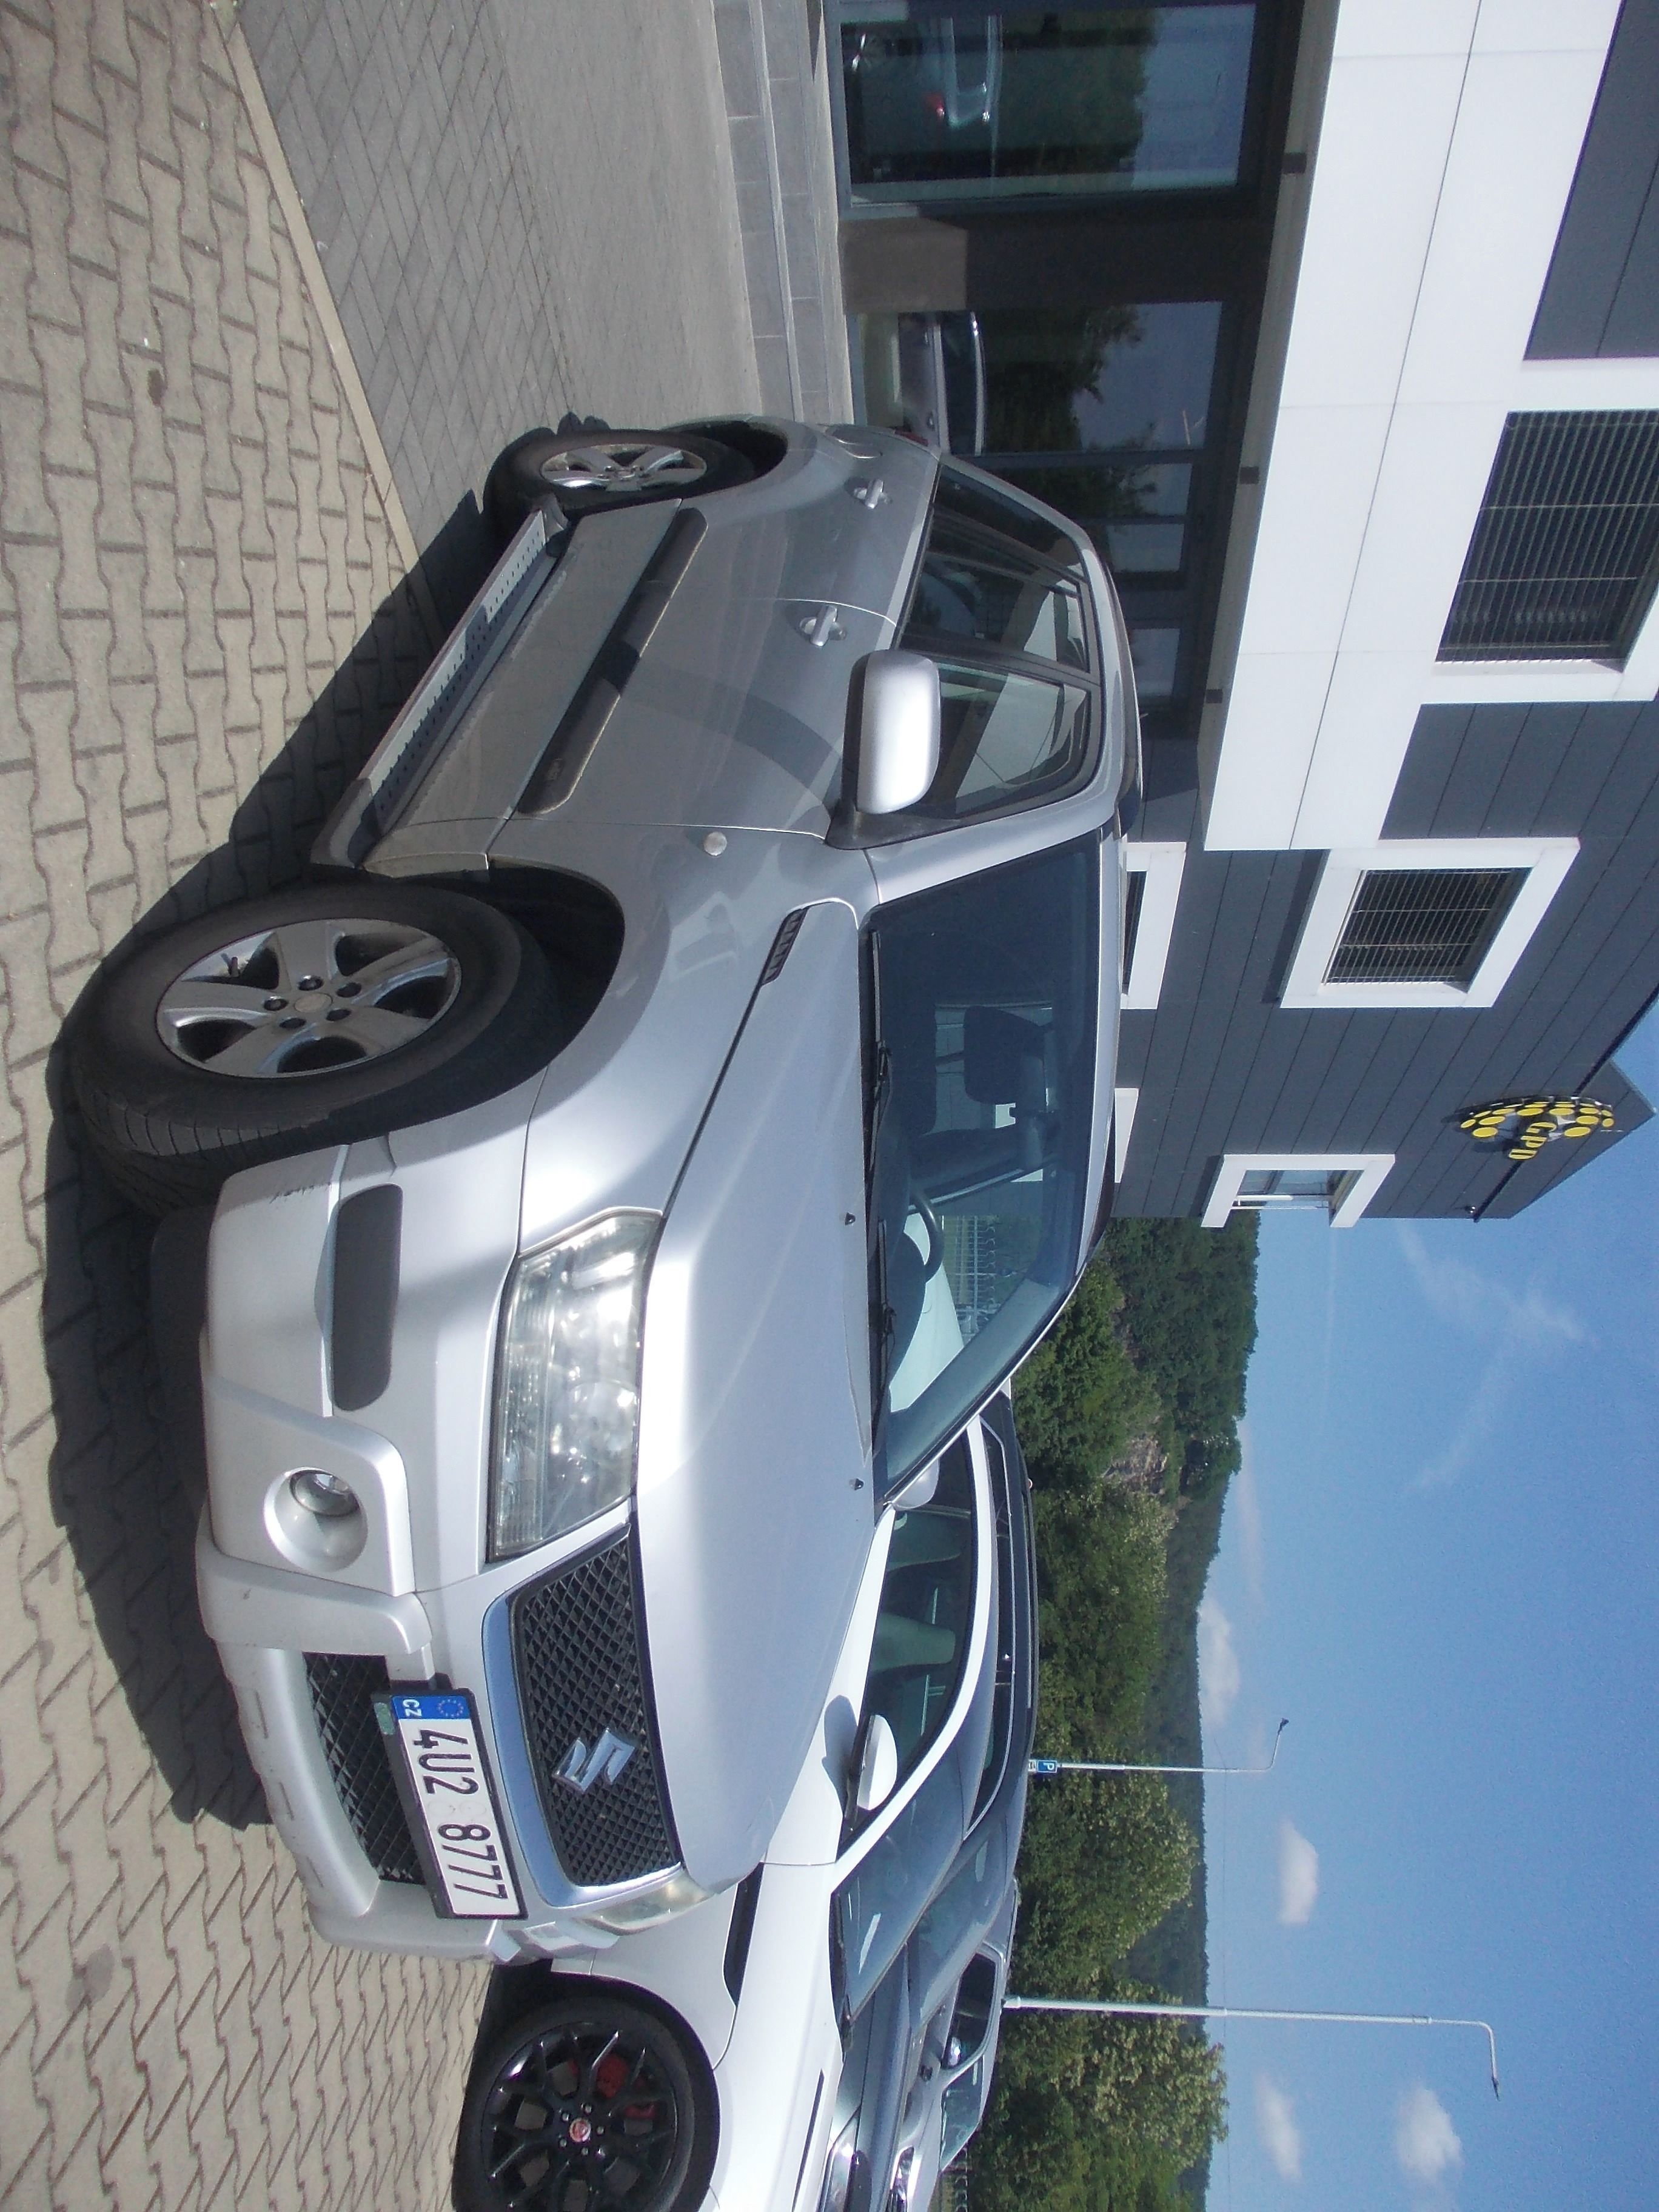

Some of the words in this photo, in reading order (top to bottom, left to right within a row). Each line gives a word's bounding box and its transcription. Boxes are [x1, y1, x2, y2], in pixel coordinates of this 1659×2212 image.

[1509, 1122, 1557, 1159] GPD
[403, 1699, 422, 1718] CZ
[412, 1729, 479, 1795] 4U2
[438, 1823, 509, 1900] 8777
